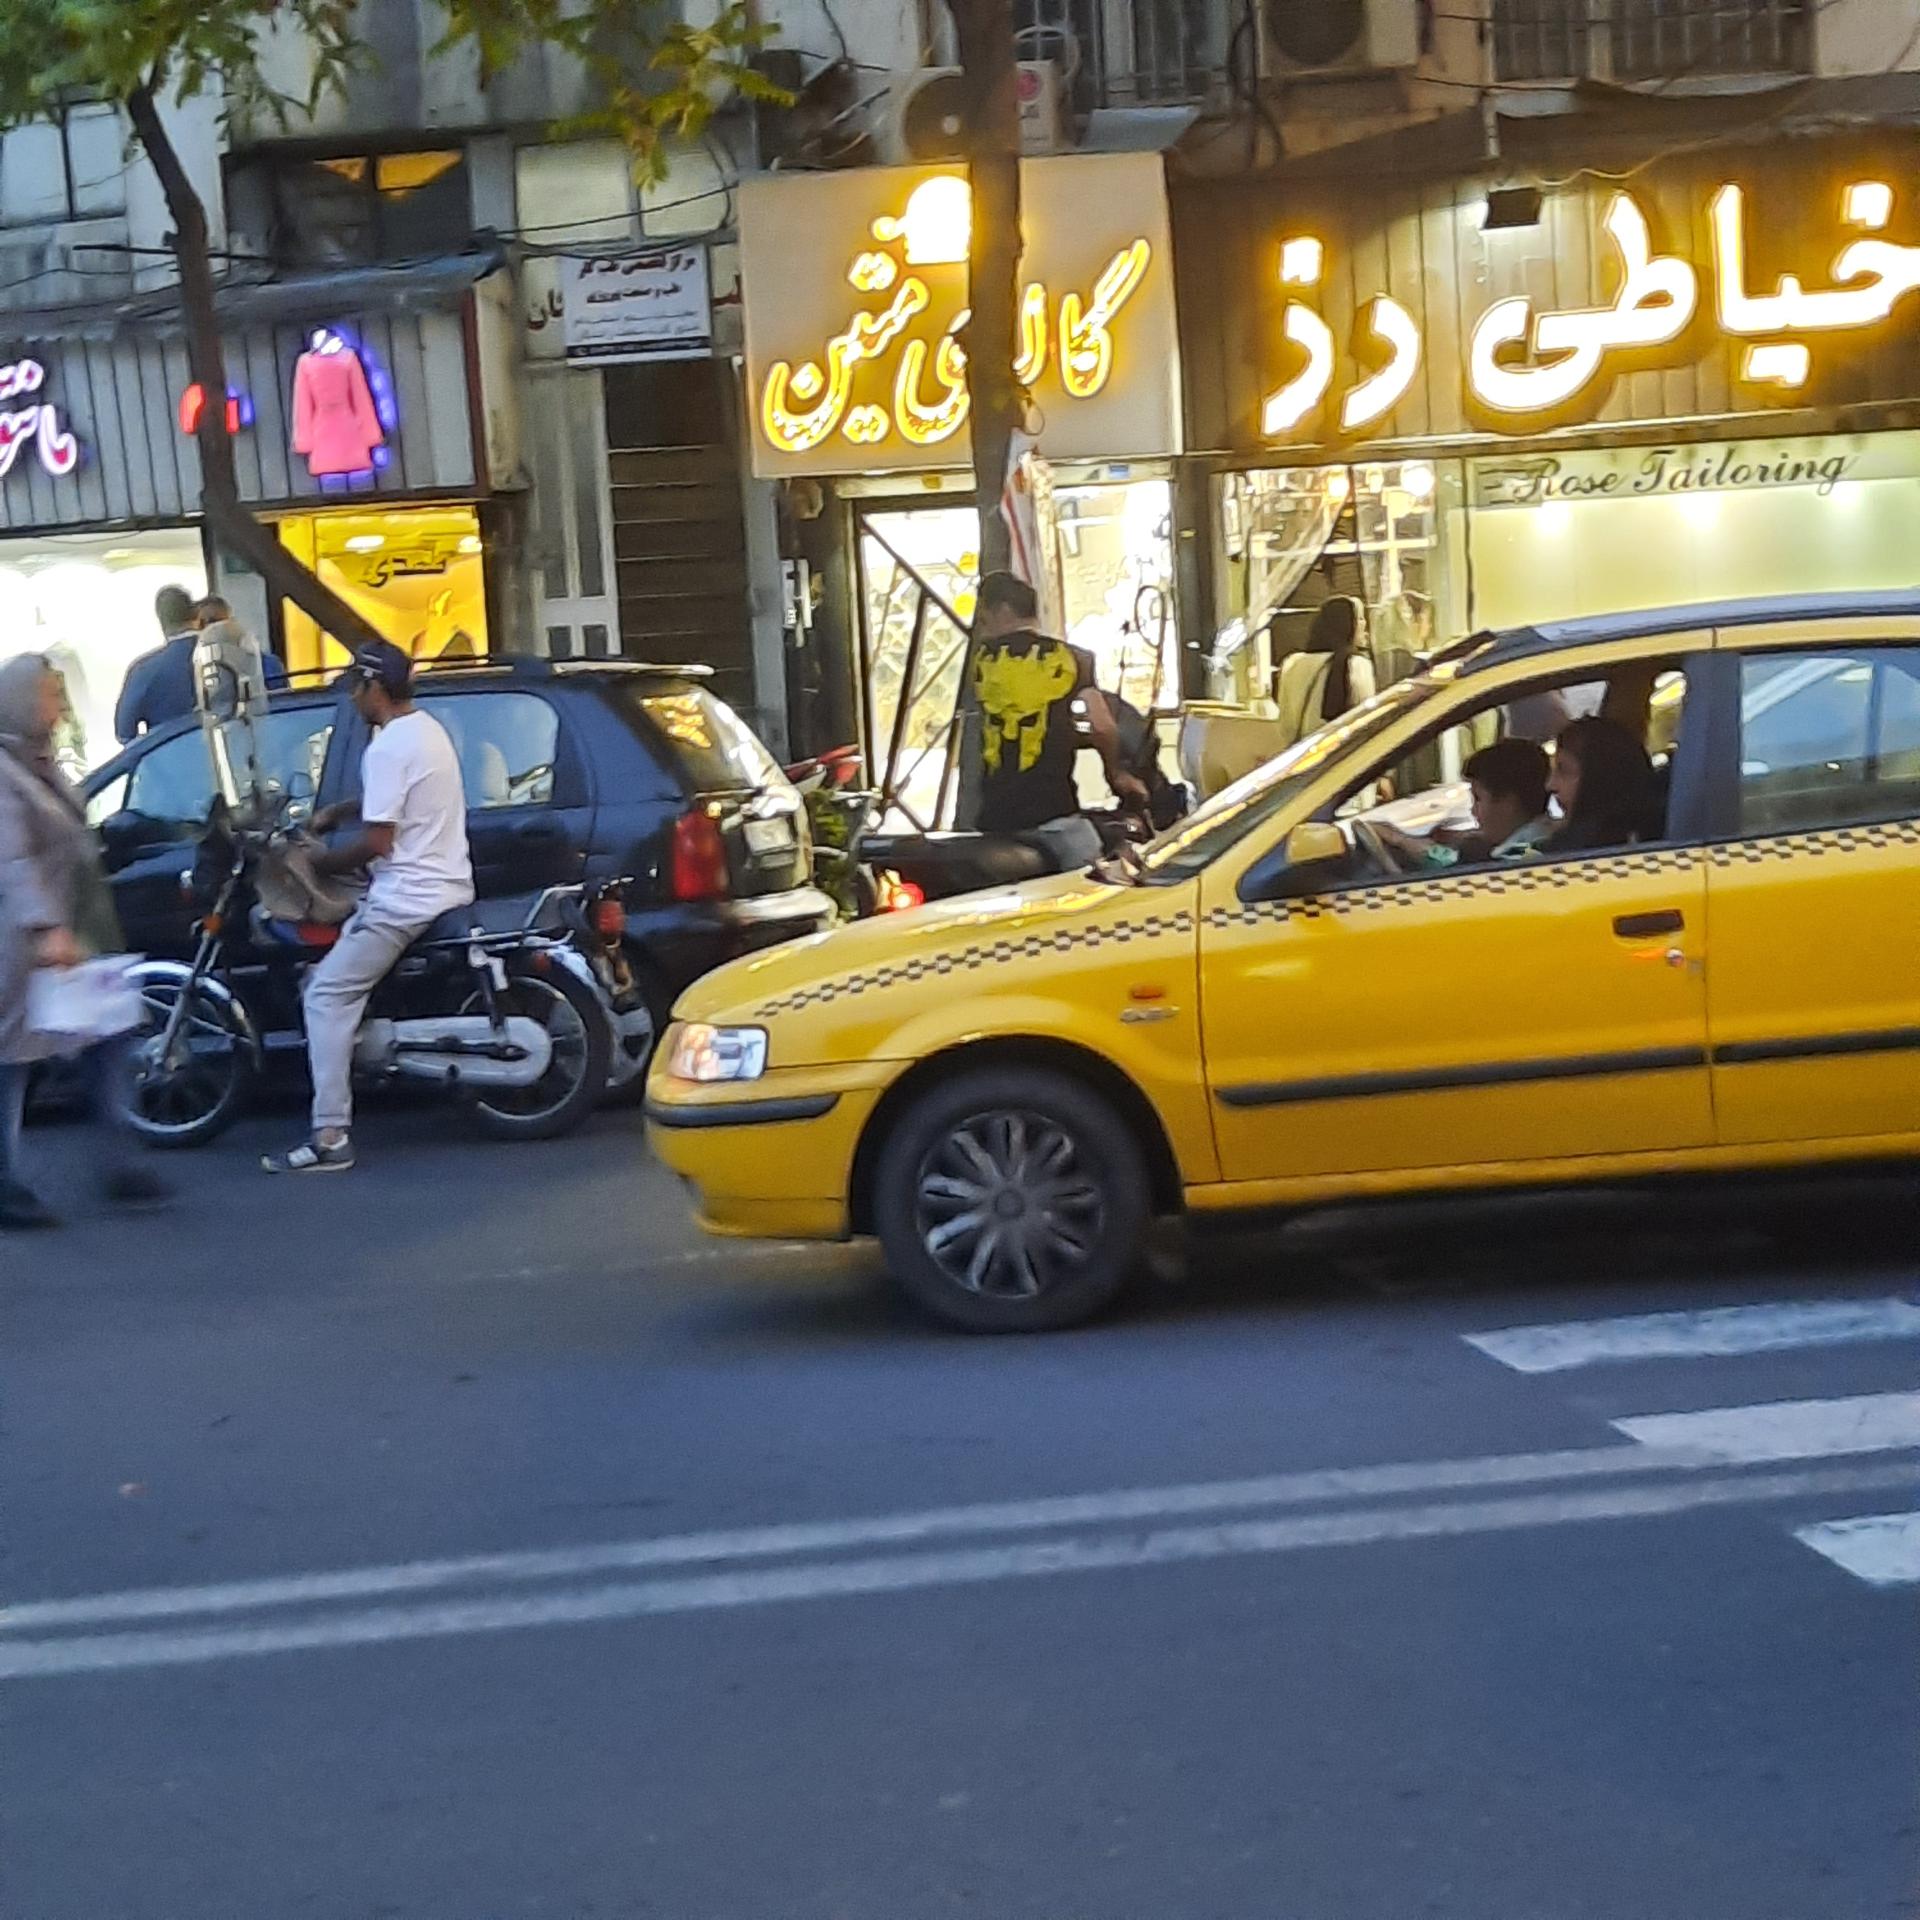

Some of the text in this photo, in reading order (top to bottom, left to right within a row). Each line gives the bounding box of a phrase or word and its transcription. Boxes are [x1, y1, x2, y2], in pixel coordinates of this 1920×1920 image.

[894, 238, 1150, 444] گالی
[1261, 181, 1920, 436] خیاطی رز
[1510, 446, 1856, 501] Rose Tailoring
